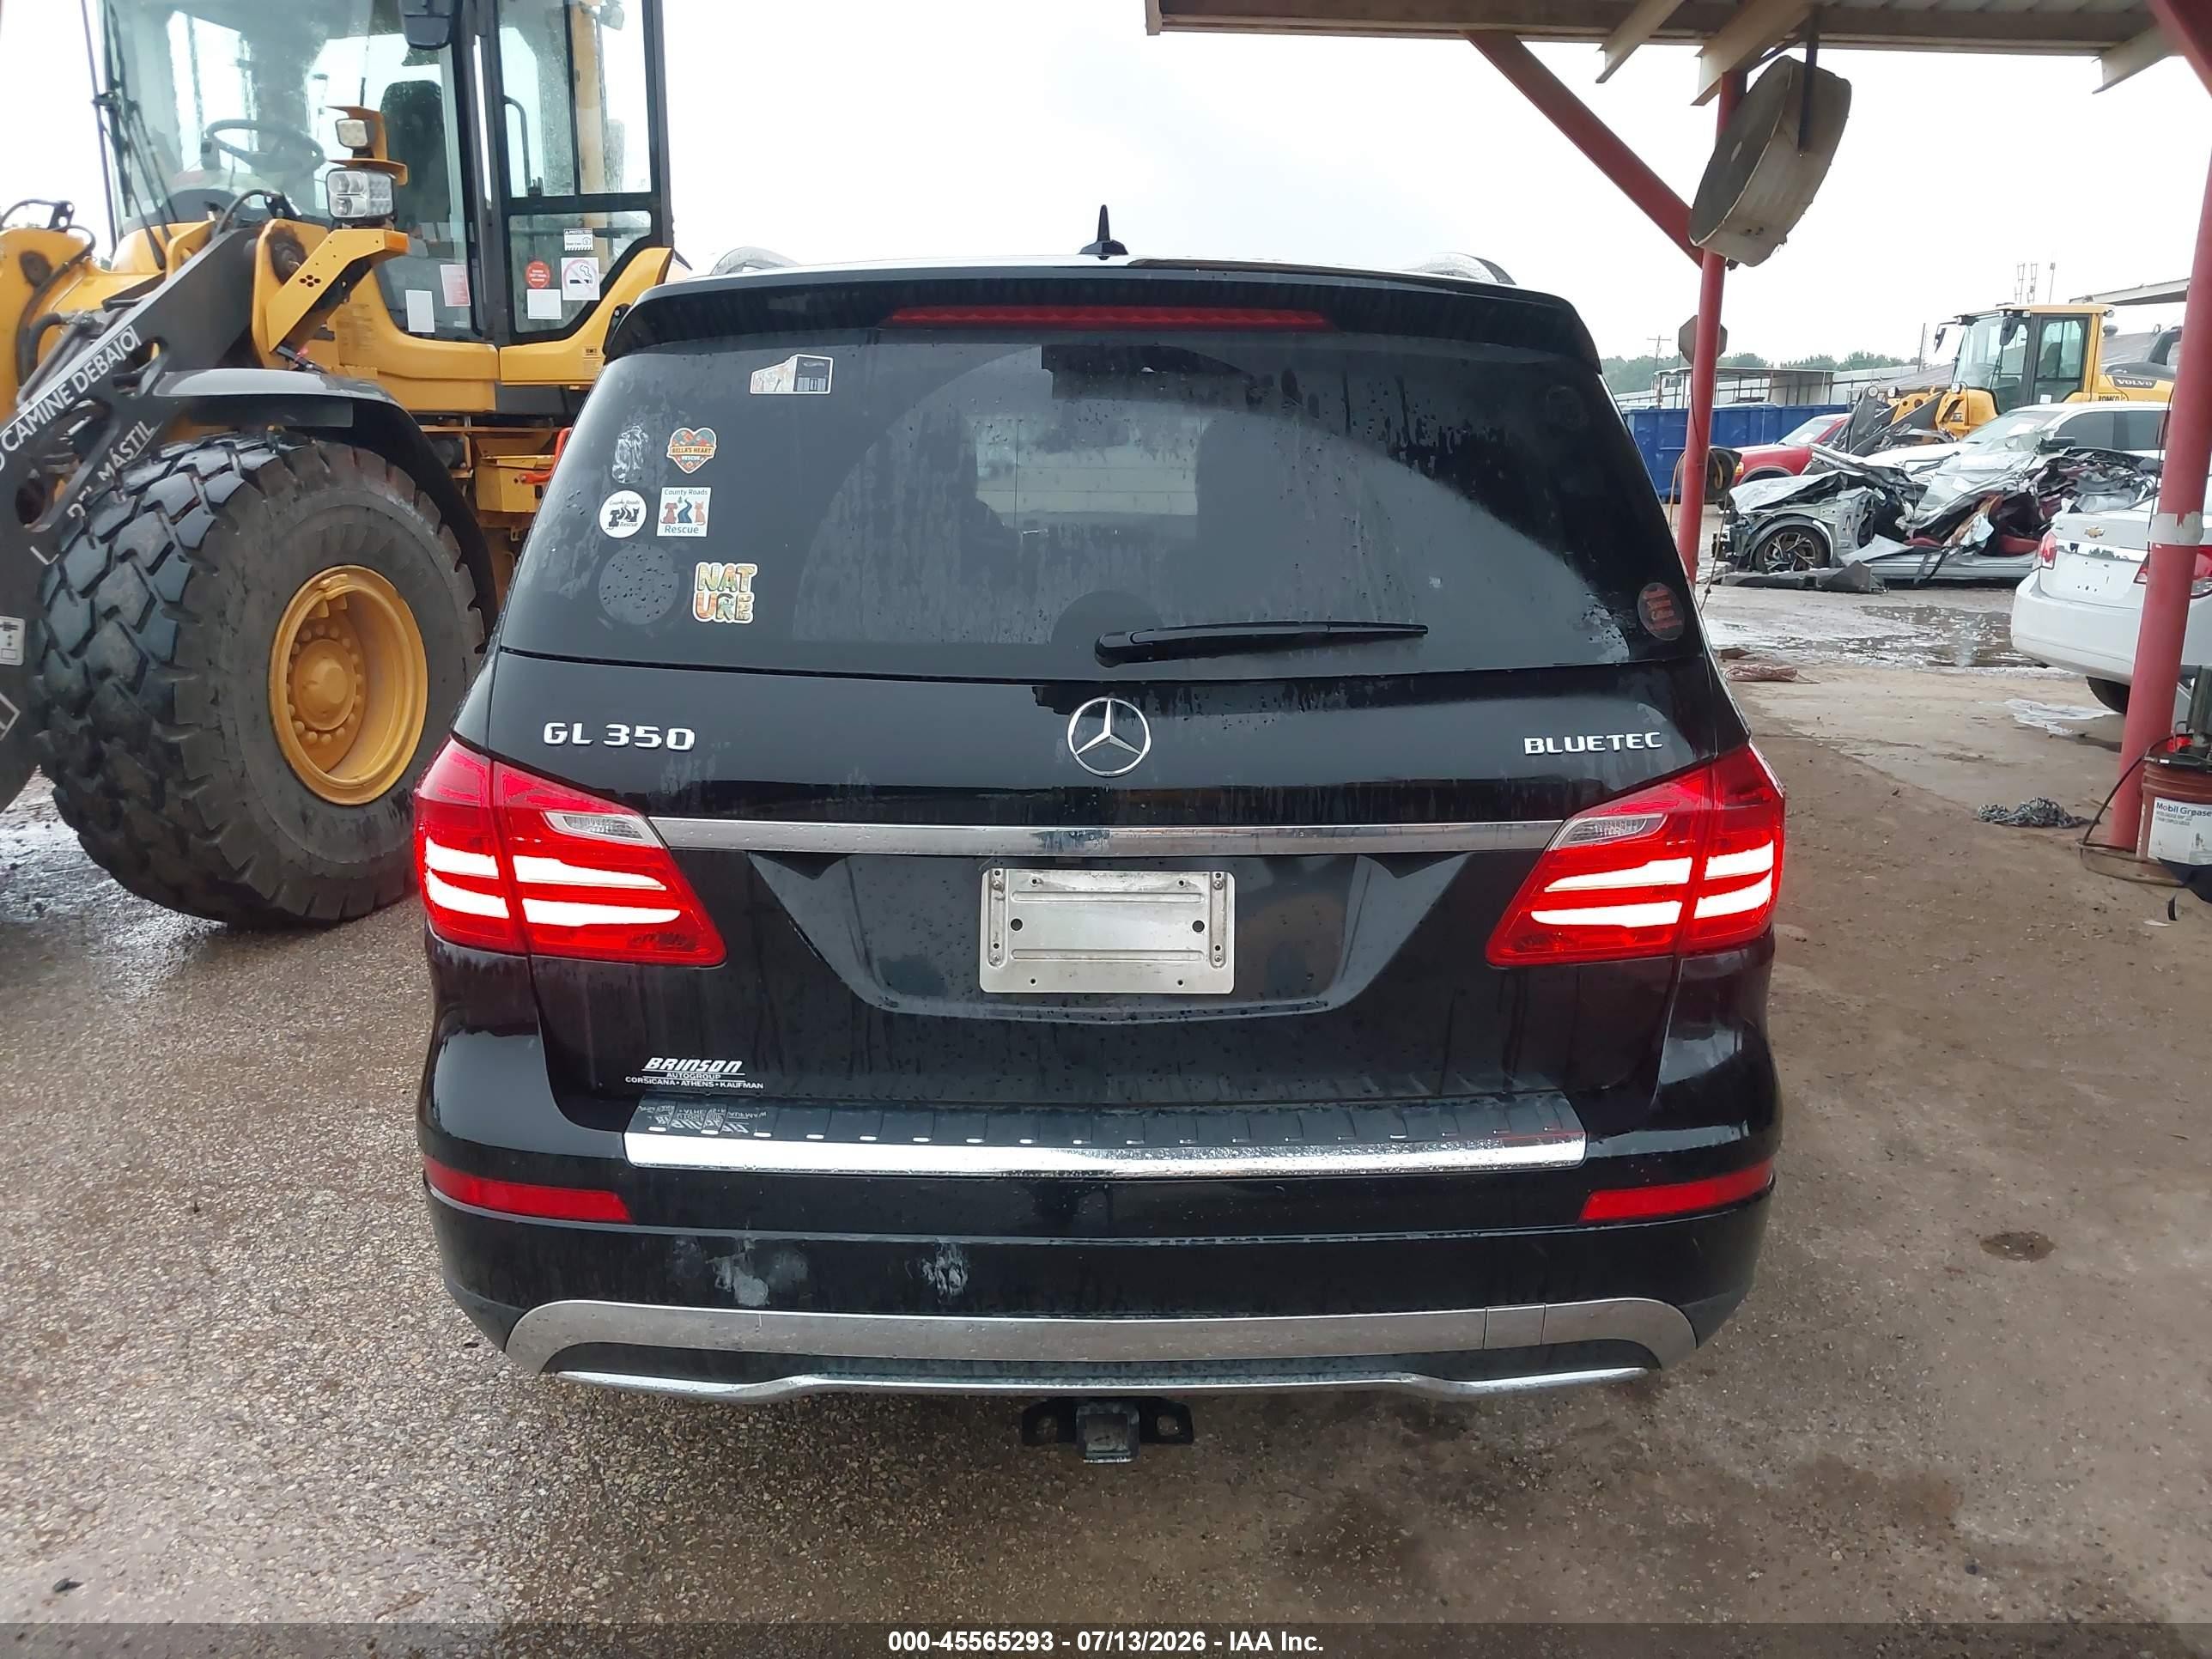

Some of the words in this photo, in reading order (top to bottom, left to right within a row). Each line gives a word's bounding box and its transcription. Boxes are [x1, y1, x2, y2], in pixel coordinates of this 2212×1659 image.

[2, 383, 76, 451] CAMINE
[71, 331, 137, 393] DEBAJO
[98, 421, 155, 482] MÁSTIL
[665, 525, 699, 534] Rescue
[696, 563, 756, 592] NAT
[696, 592, 752, 621] URE
[544, 722, 593, 745] GL
[603, 723, 696, 751] 350
[1523, 732, 1663, 755] BLUETEC
[2156, 802, 2179, 812] Mobil
[2180, 806, 2212, 817] Grease
[644, 1057, 743, 1073] BRINSON
